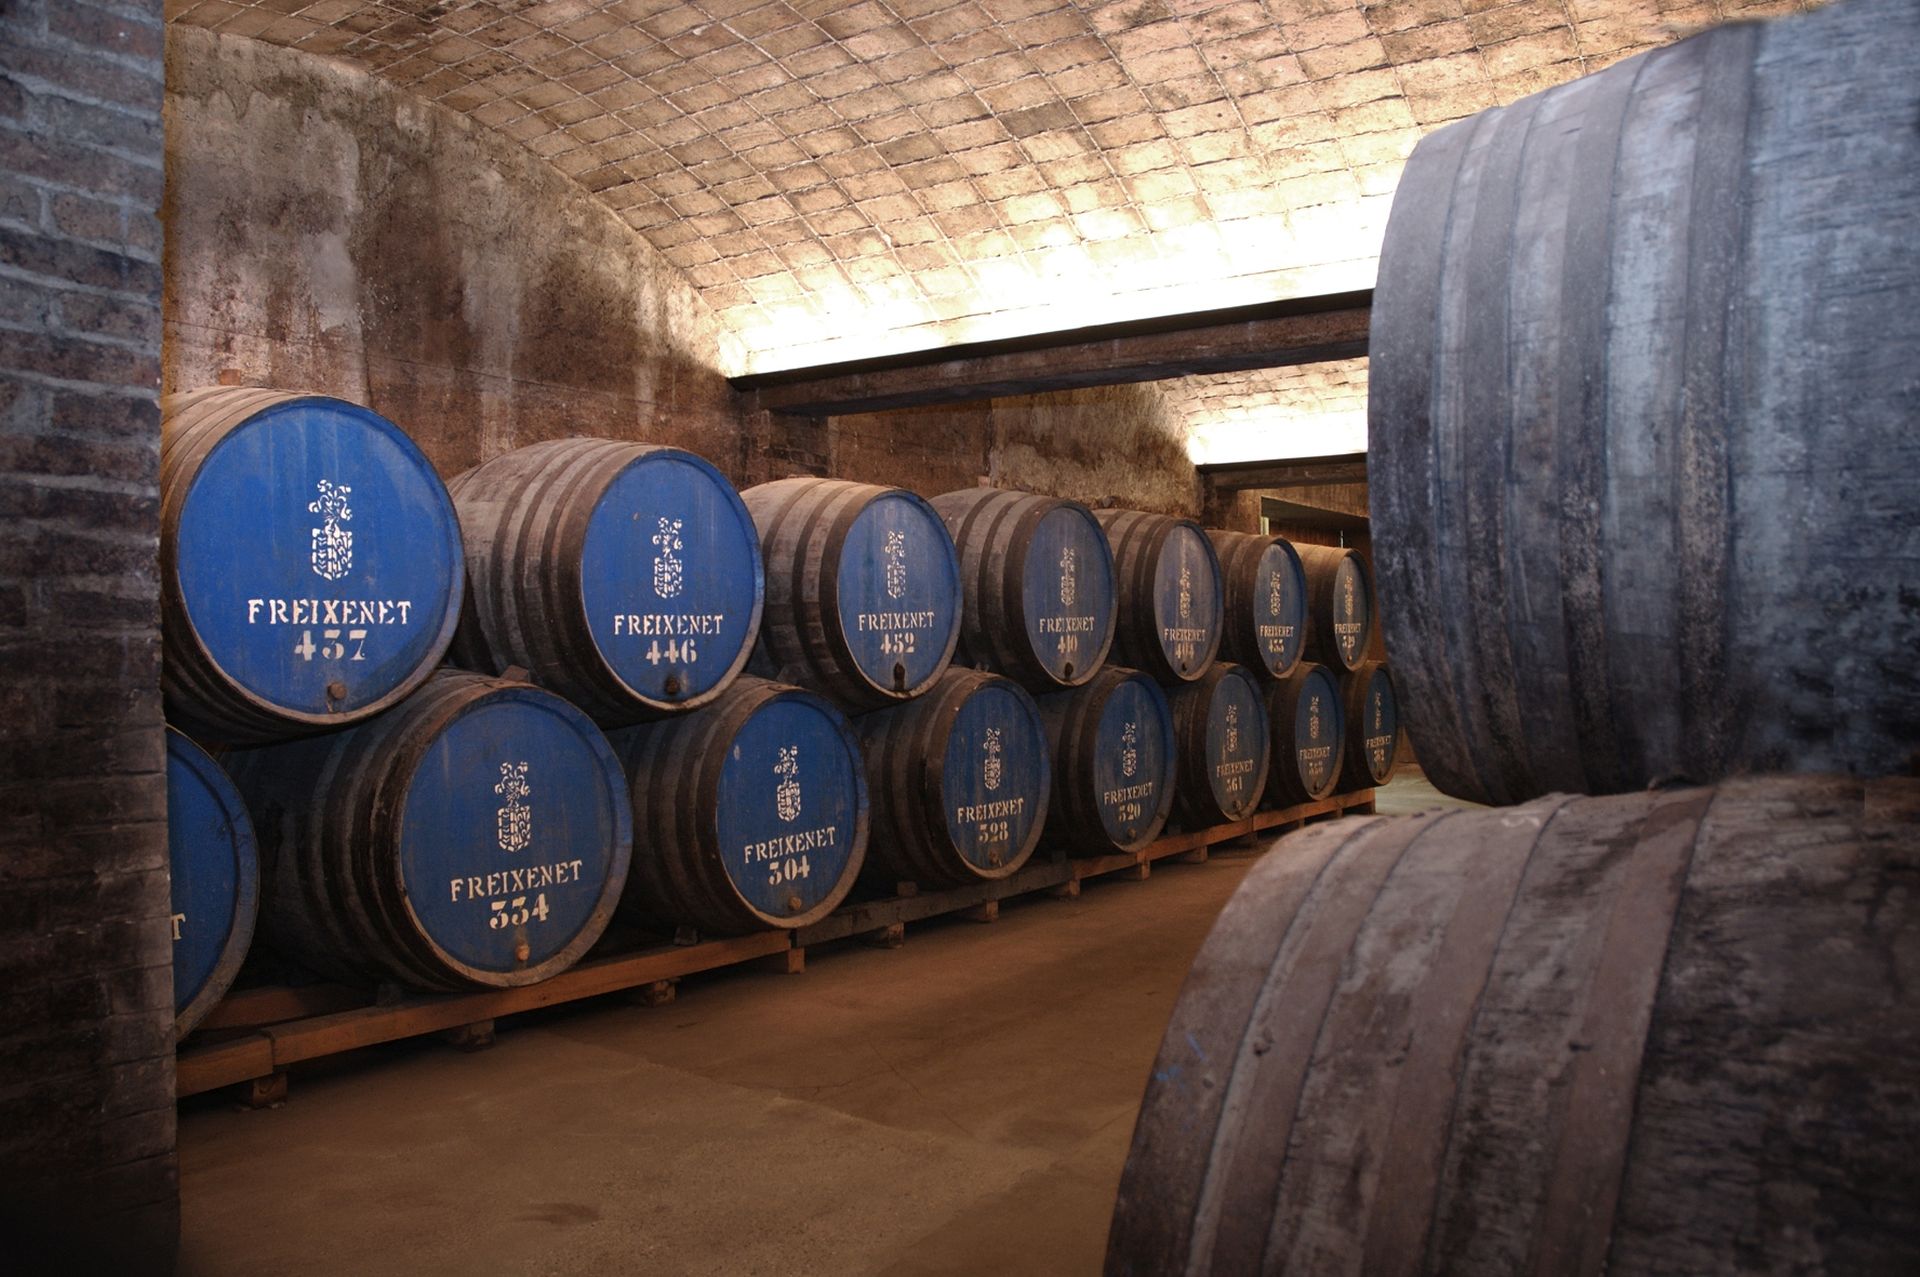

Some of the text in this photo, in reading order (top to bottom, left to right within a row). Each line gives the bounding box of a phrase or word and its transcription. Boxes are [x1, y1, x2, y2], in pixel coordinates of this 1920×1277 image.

[248, 599, 412, 625] FREIXENET
[858, 612, 935, 632] FREIXENET
[614, 614, 724, 635] FREIXENET
[1039, 616, 1095, 633] FREIXENET
[1164, 628, 1206, 641] FREIXENET
[646, 639, 697, 665] 446
[880, 632, 915, 655] 452
[1057, 634, 1078, 654] 410
[1216, 758, 1254, 778] FREIXENET
[1104, 782, 1153, 805] FREIXENET
[957, 797, 1025, 824] FREIXENET
[744, 826, 836, 864] FREIXENET
[450, 859, 583, 903] FREIXENET
